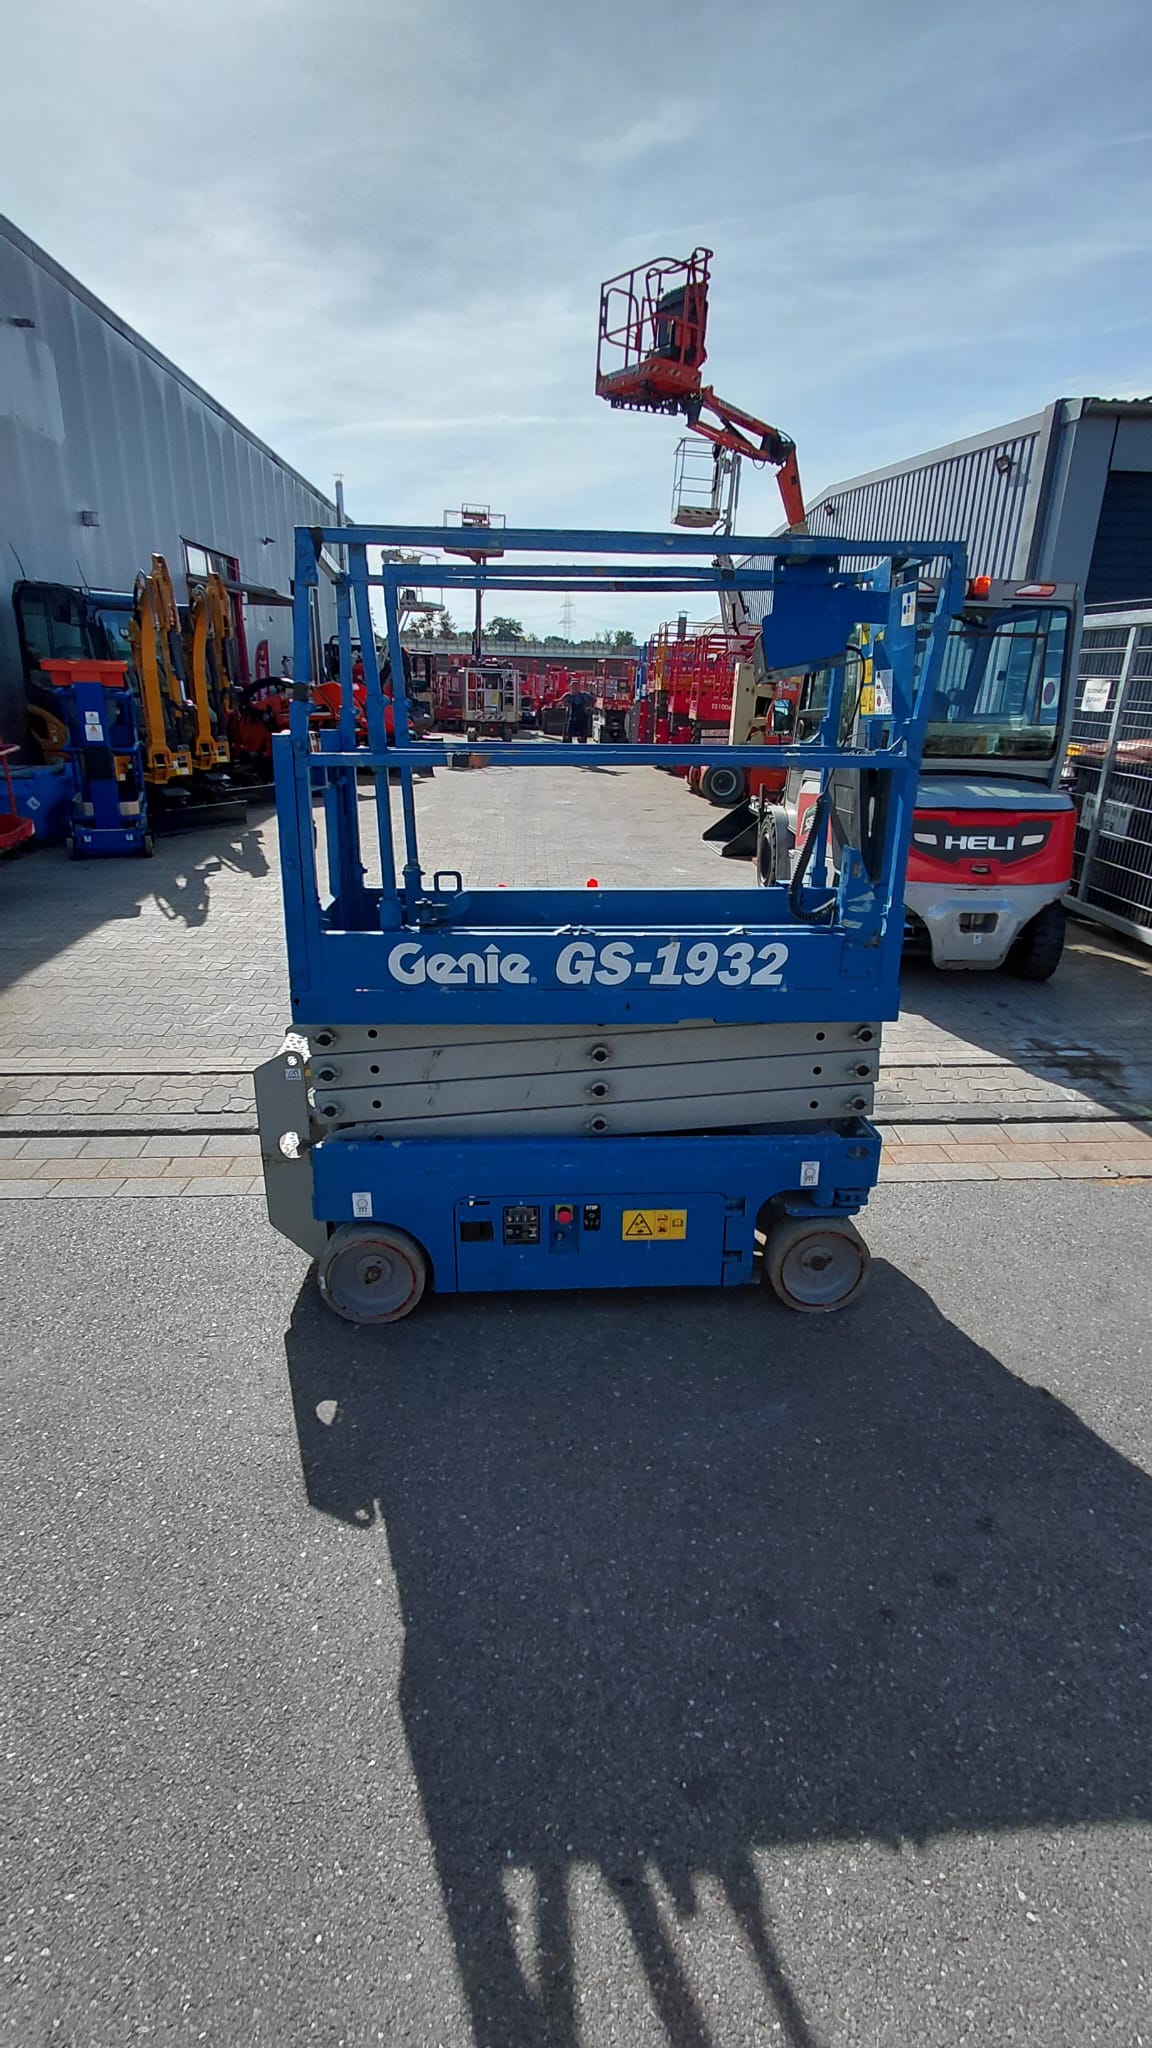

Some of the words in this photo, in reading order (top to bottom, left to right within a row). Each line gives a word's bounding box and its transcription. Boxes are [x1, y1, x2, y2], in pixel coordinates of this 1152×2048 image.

[944, 835, 1015, 851] HELI
[388, 943, 532, 985] Genie
[555, 941, 788, 986] GS-1932
